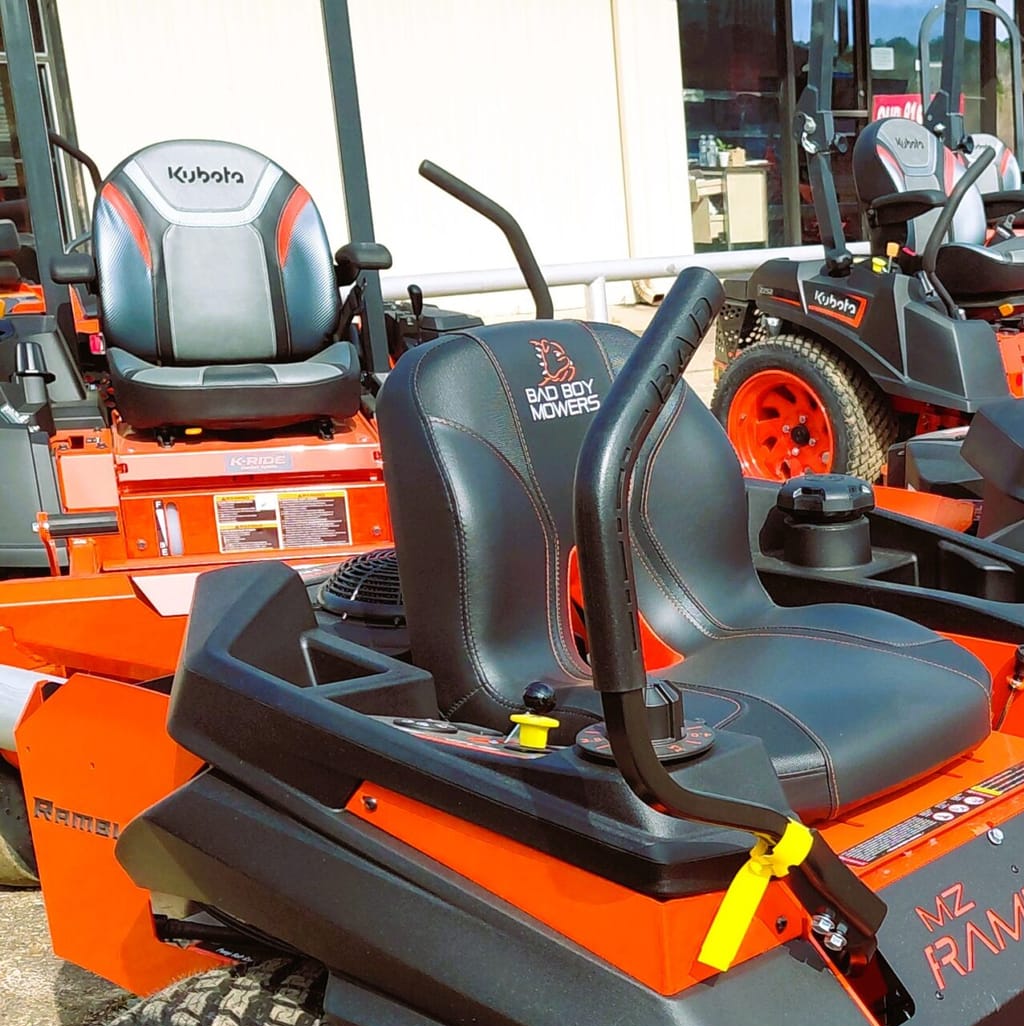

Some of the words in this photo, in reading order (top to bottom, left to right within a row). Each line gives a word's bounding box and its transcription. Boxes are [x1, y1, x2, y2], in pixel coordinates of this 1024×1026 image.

[167, 166, 244, 184] Kubota
[813, 289, 857, 315] Kubota
[525, 385, 559, 404] BAD
[560, 378, 594, 400] BOY
[529, 394, 601, 421] MOWERS
[914, 881, 977, 932] MZ
